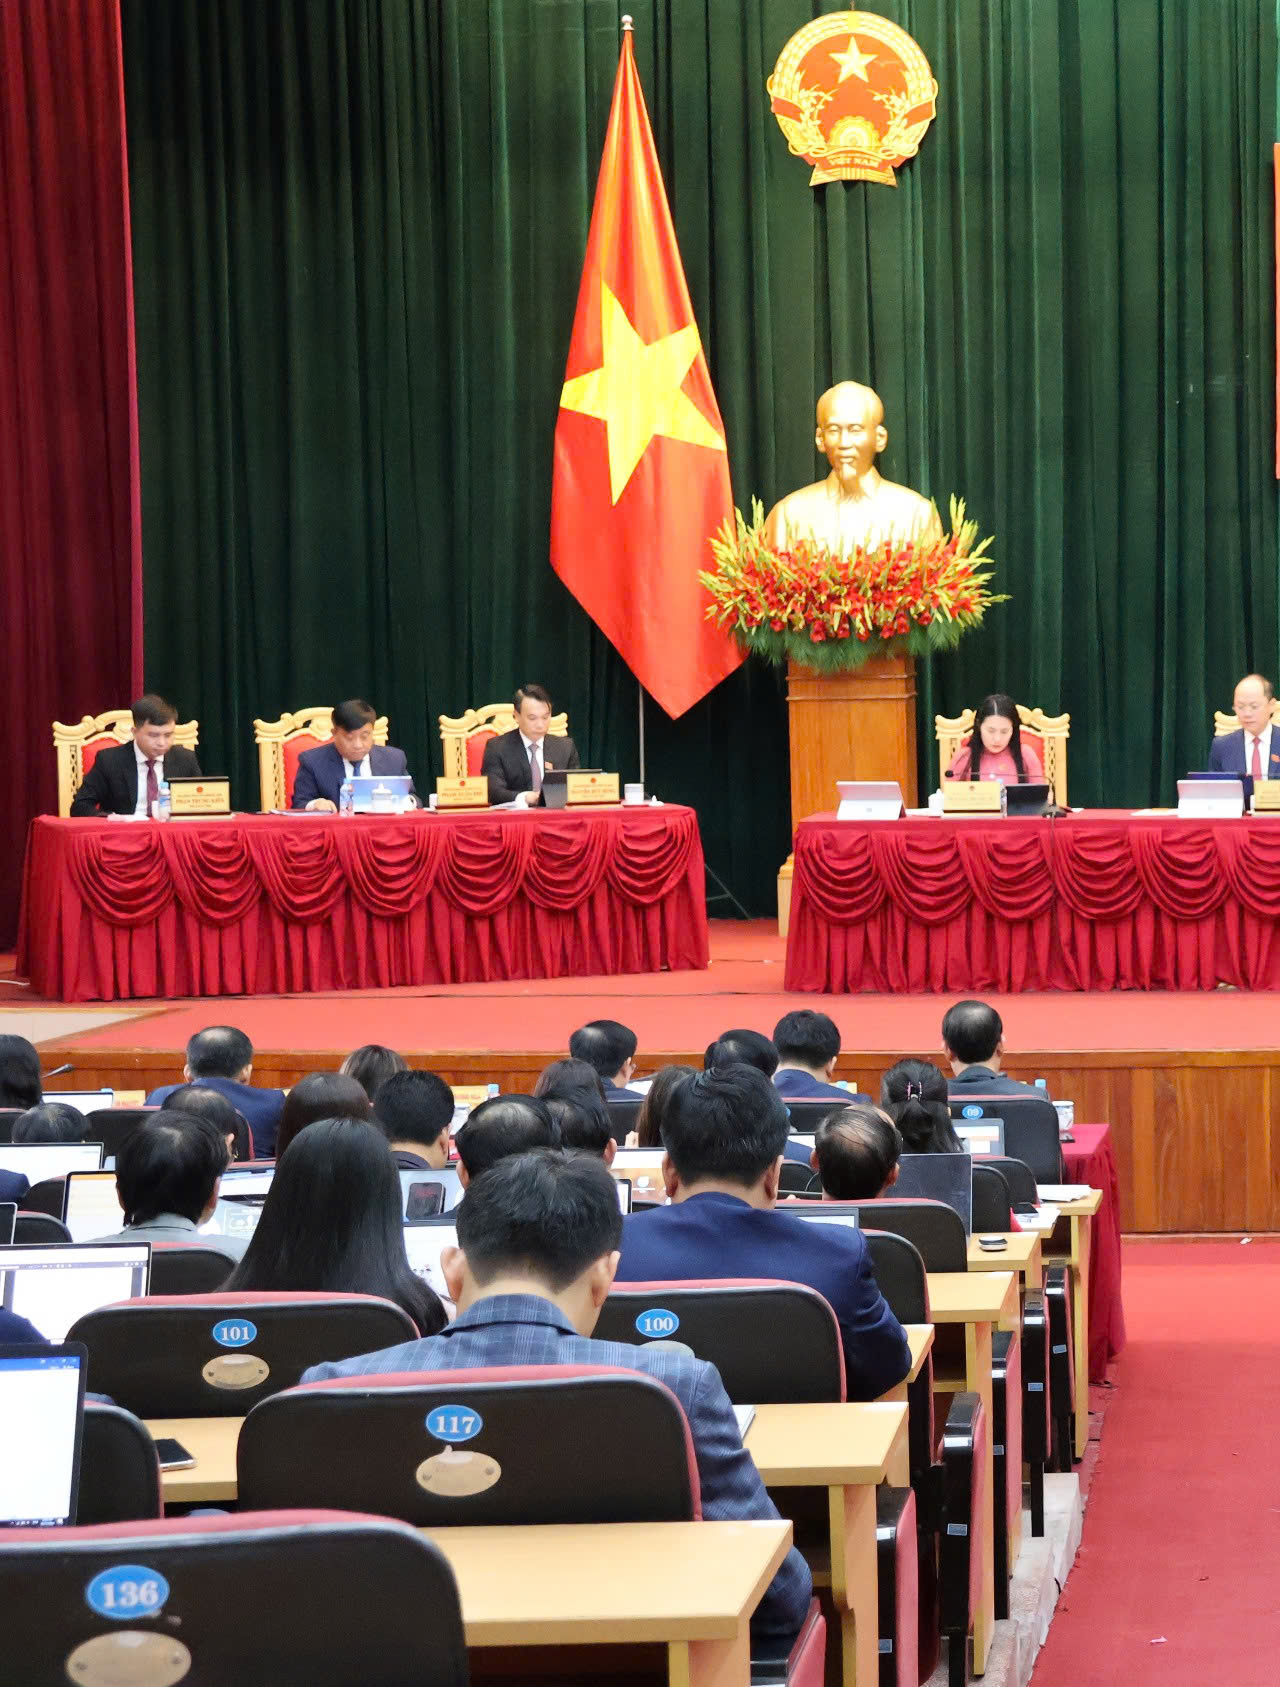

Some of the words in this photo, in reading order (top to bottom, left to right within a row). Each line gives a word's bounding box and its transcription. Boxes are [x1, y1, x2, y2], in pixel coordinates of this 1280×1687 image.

[219, 1324, 252, 1343] 101
[643, 1313, 674, 1334] 100
[435, 1415, 475, 1434] 117
[101, 1581, 158, 1608] 136
